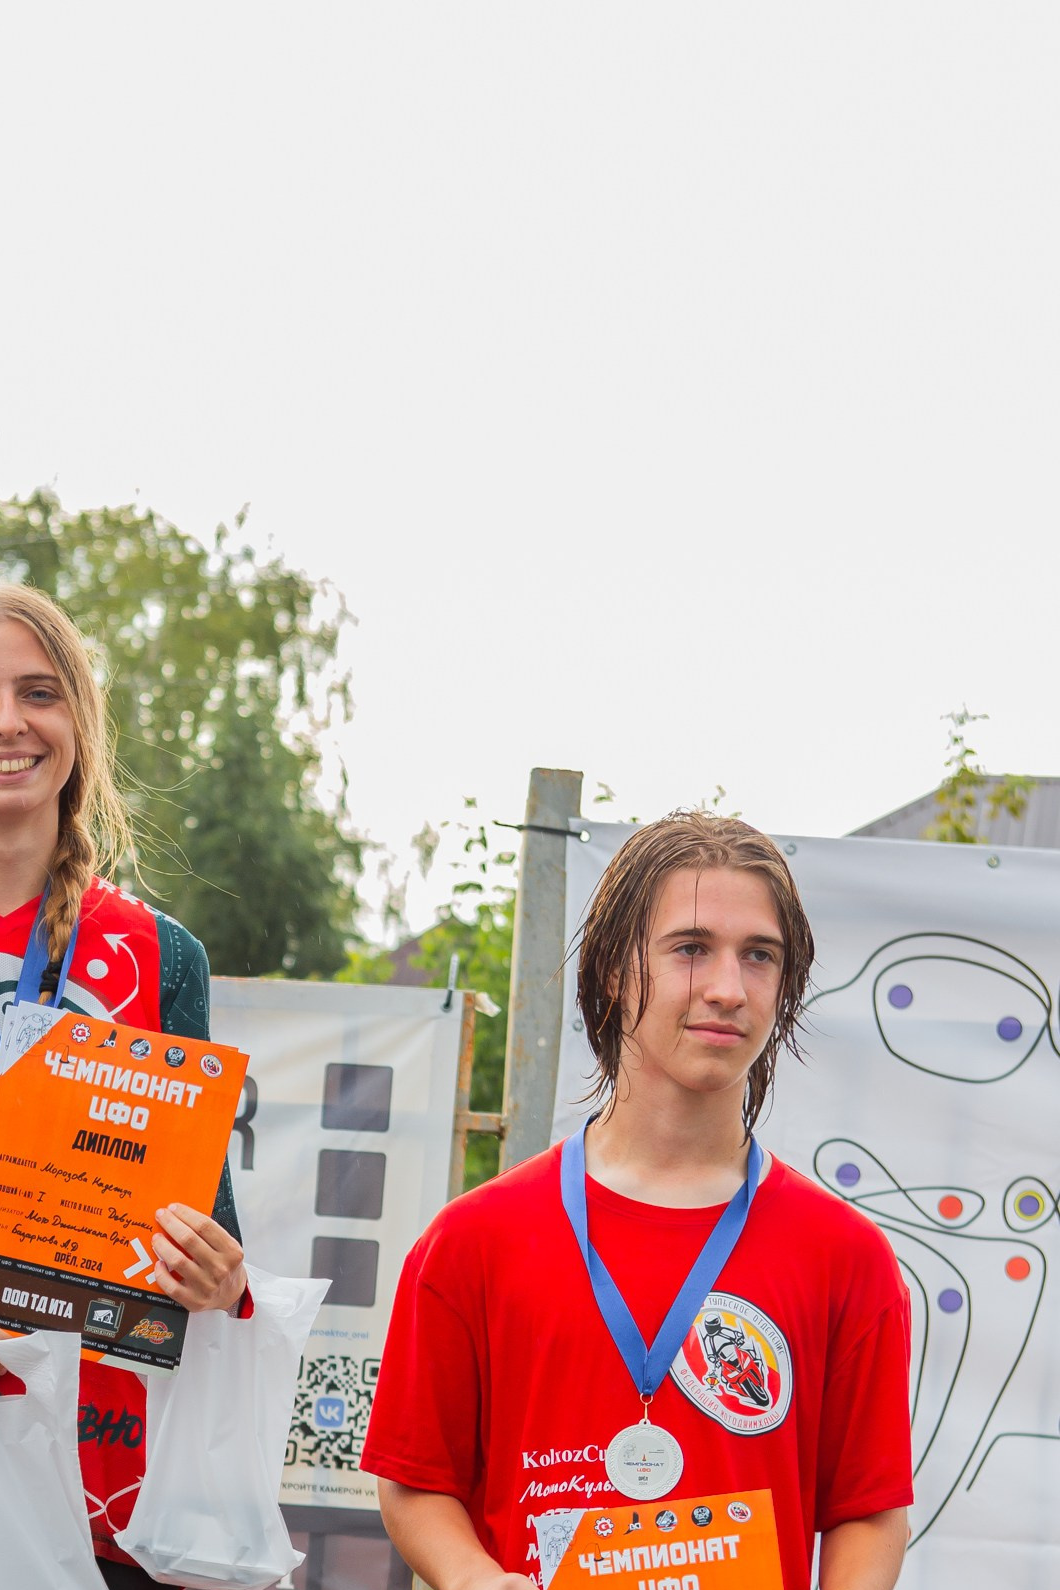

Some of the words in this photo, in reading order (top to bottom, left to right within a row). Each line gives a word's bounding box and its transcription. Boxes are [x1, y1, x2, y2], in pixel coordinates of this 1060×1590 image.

[44, 1050, 202, 1109] ЧЕМПИОНАТ
[88, 1095, 150, 1131] ЦФО
[72, 1129, 148, 1164] ДИПЛОМ
[40, 1162, 88, 1183] Морозова
[60, 1199, 77, 1210] МЕСТО
[83, 1204, 103, 1216] КЛАССЕ
[80, 1258, 103, 1273] 2024
[30, 1293, 48, 1314] ТД
[48, 1297, 74, 1320] ИТА
[708, 1297, 750, 1316] ТУЛЬСКОЕ
[753, 1315, 786, 1356] ОТДЕЛЕНИЕ
[680, 1368, 719, 1411] ФЕДЕРАЦИЯ
[280, 1482, 317, 1493] КРОЙТЕ
[319, 1484, 362, 1496] КАМЕРОЙ
[519, 1475, 620, 1503] МотоКуль
[578, 1534, 741, 1577] ЧЕМПИОНАТ
